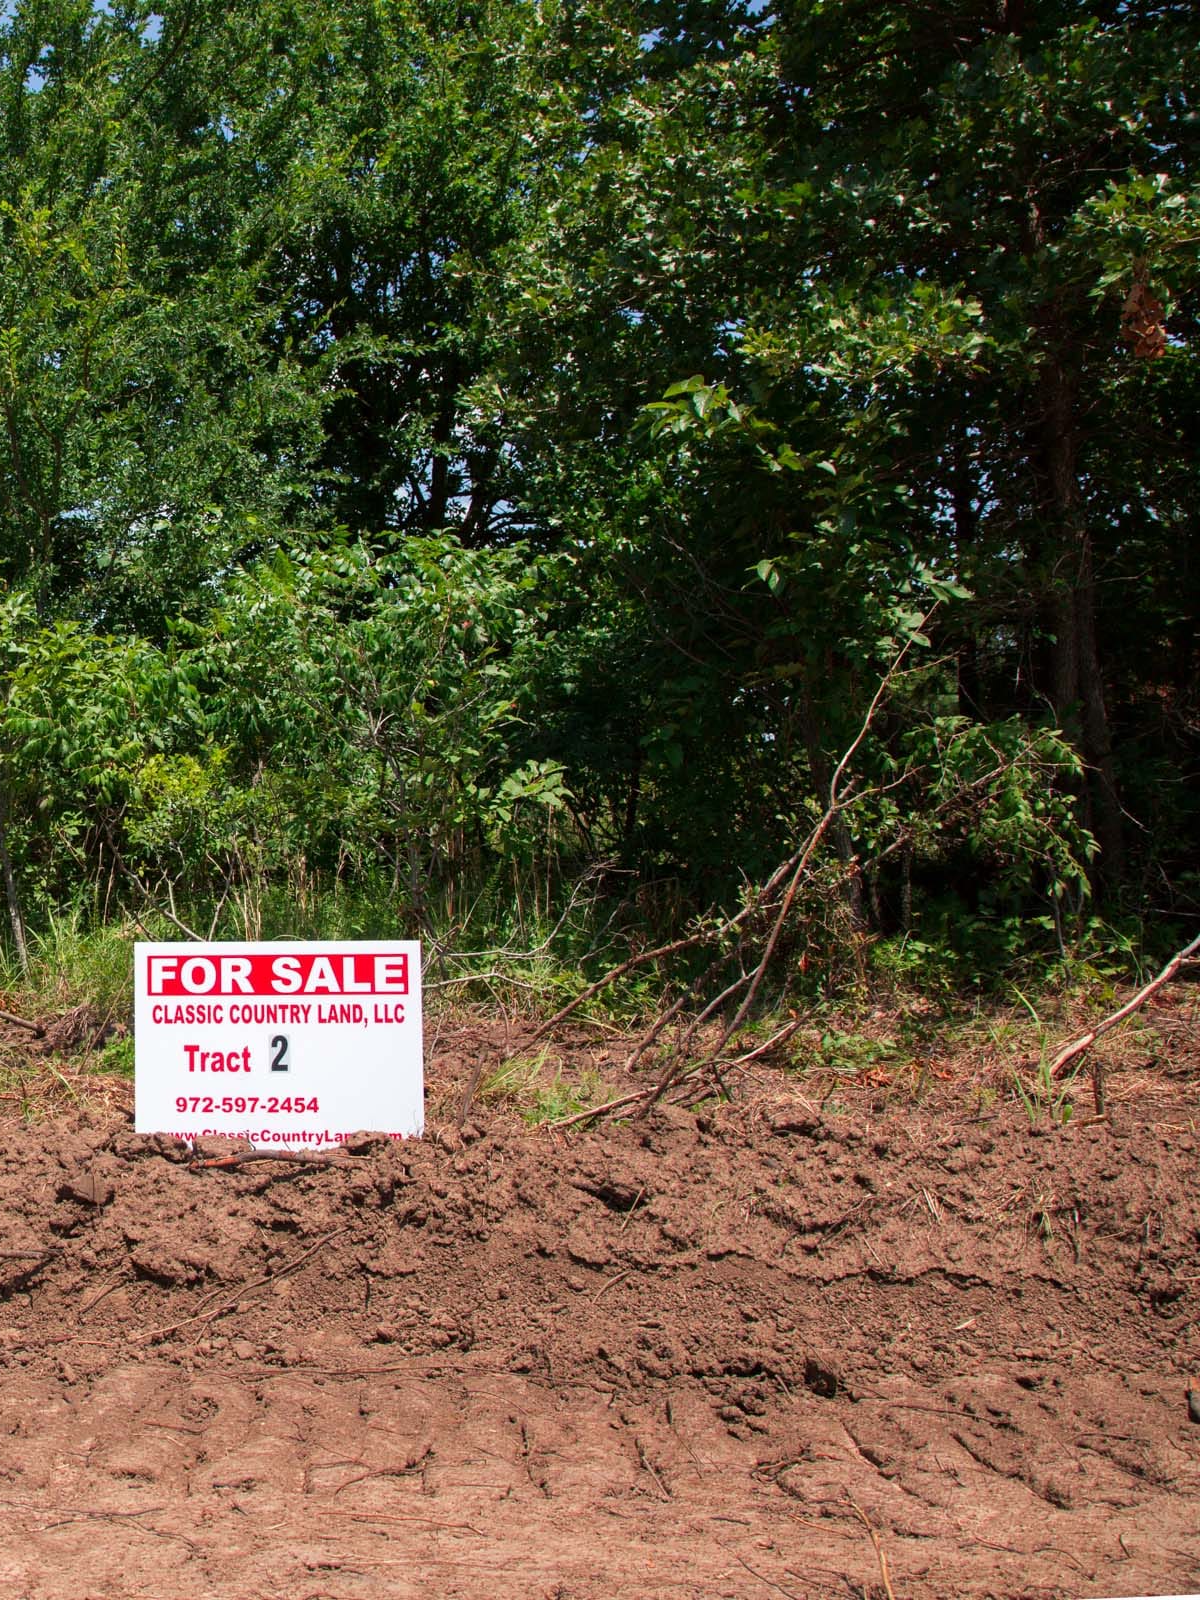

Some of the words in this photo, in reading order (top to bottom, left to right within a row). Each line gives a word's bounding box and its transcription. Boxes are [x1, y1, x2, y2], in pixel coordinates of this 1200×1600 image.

[151, 957, 255, 994] FOR
[271, 956, 405, 993] SALE
[152, 1004, 224, 1025] CLASSIC
[229, 1004, 312, 1025] COUNTRY
[317, 1003, 369, 1028] LAND,
[373, 1003, 405, 1024] LLC
[183, 1044, 252, 1073] Tract
[271, 1034, 289, 1072] 2
[175, 1096, 320, 1114] 972-597-2454
